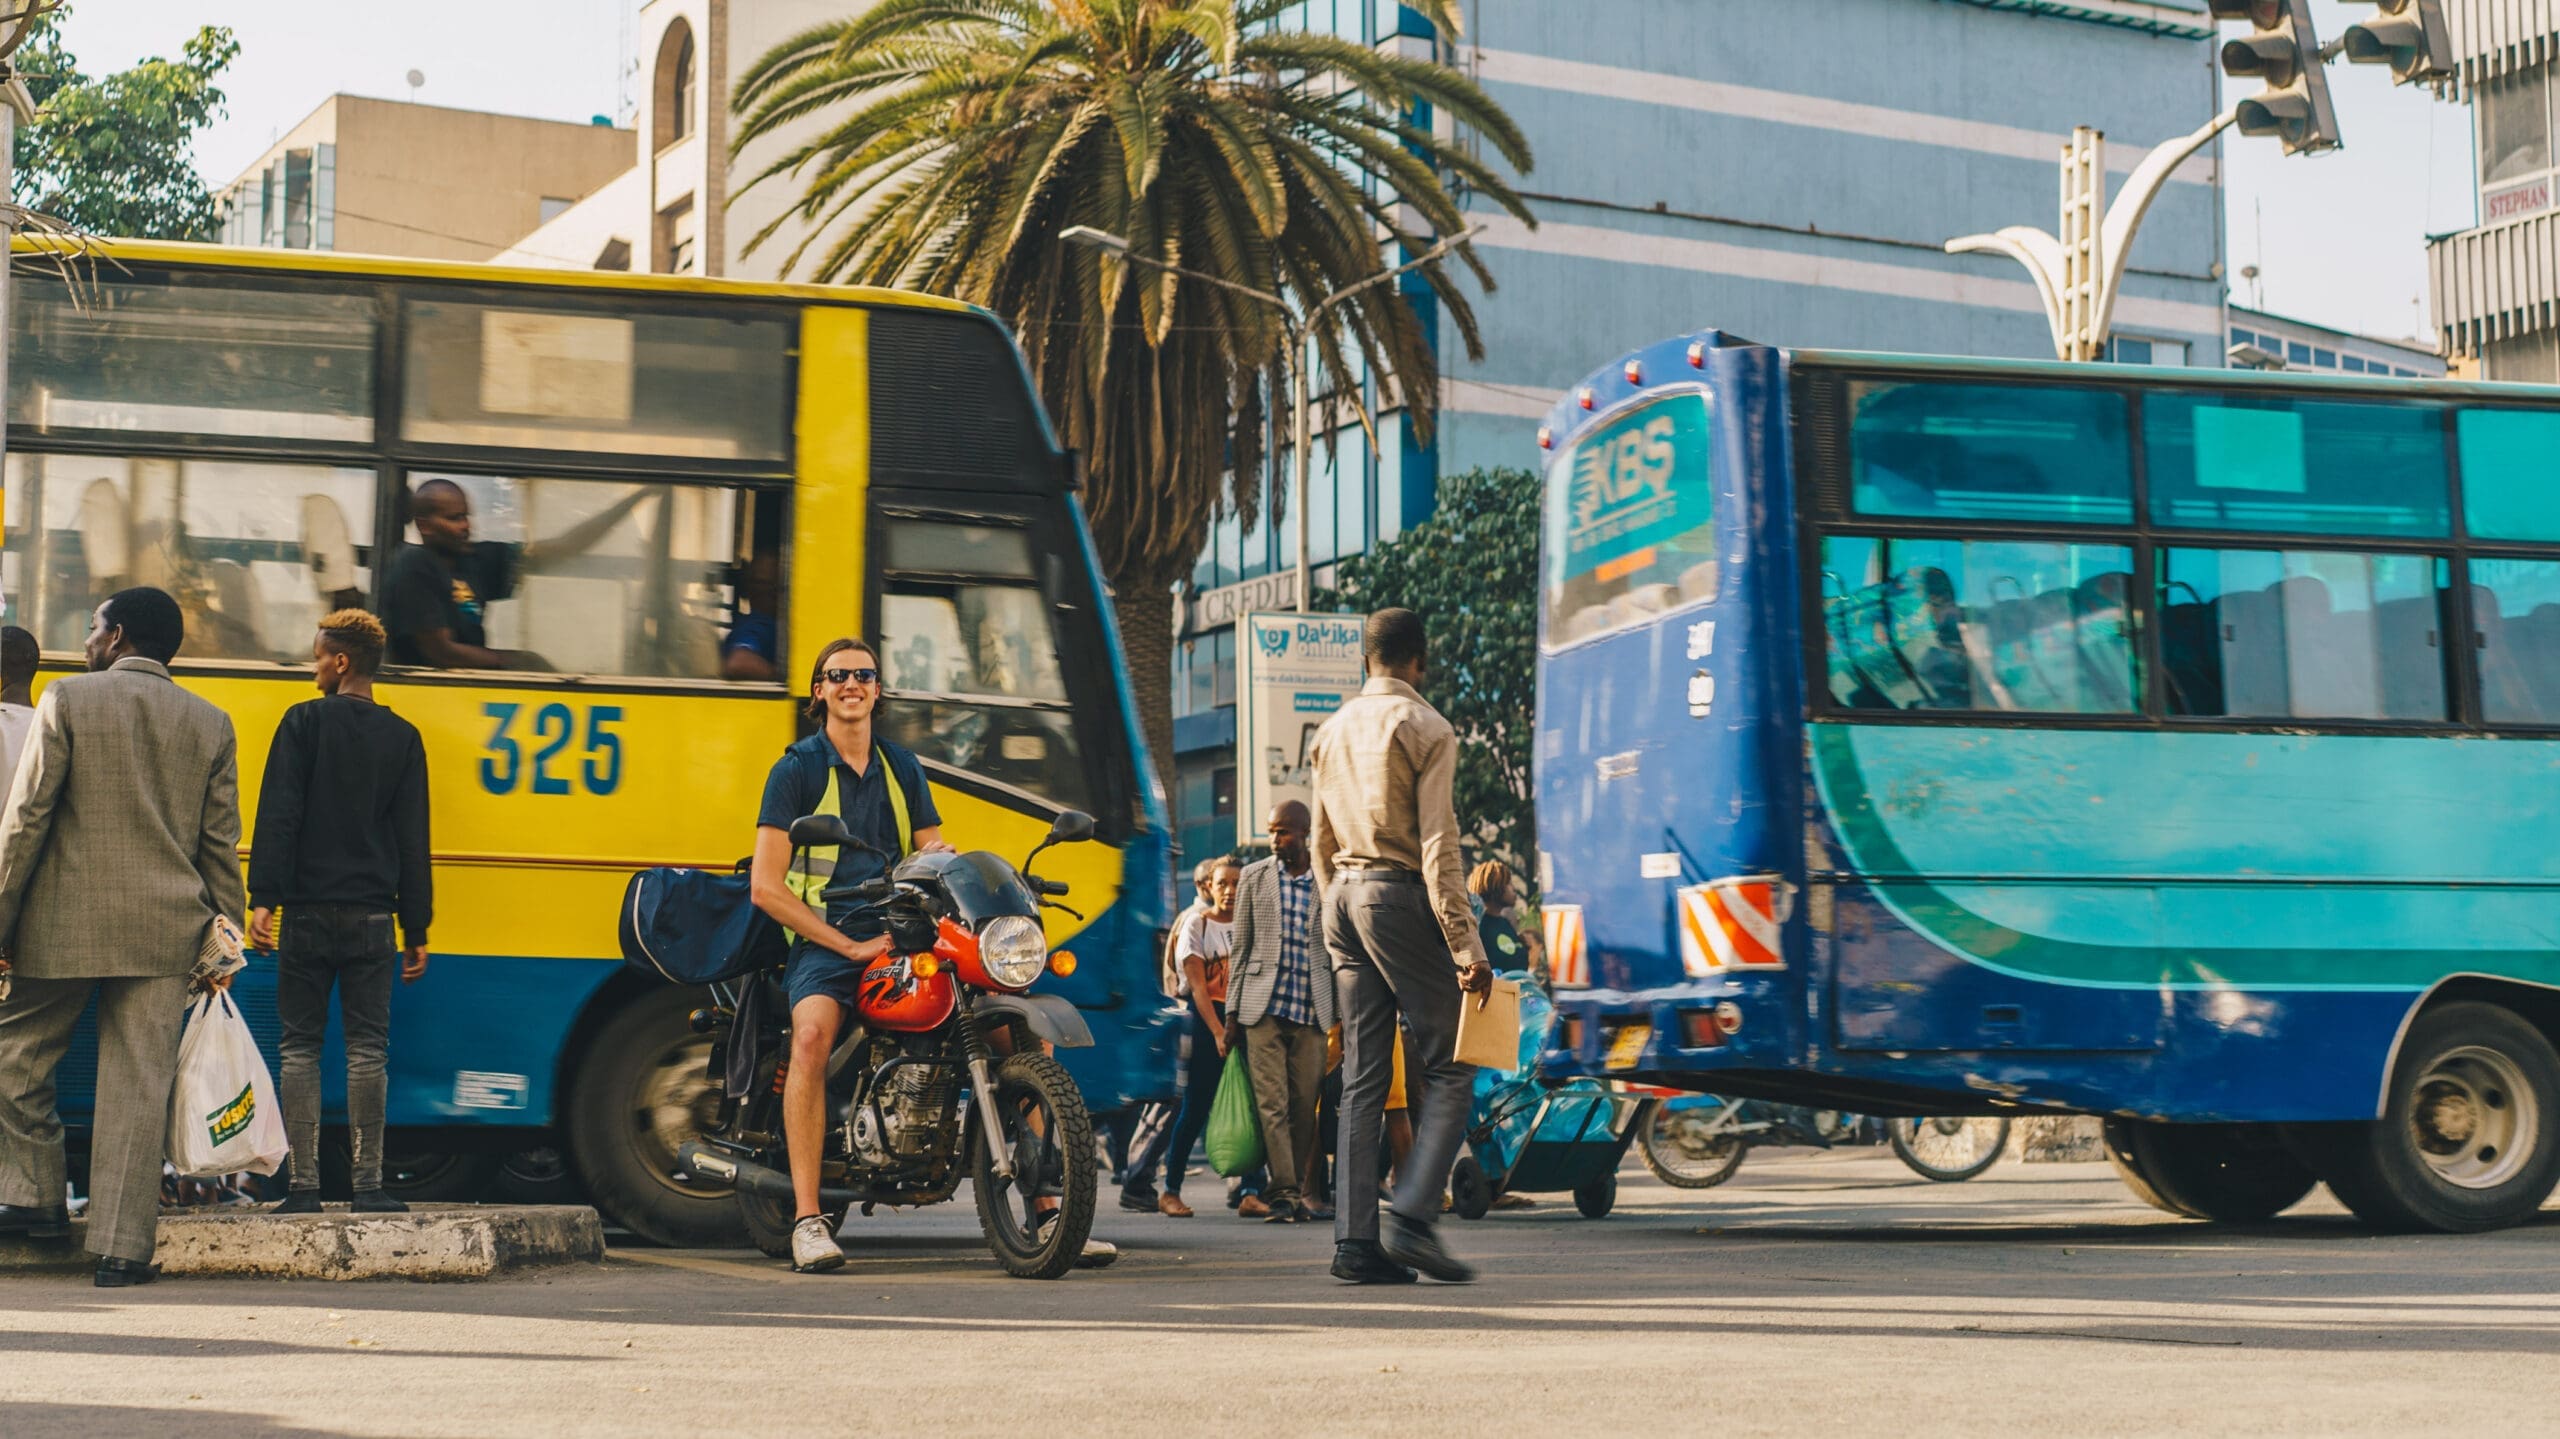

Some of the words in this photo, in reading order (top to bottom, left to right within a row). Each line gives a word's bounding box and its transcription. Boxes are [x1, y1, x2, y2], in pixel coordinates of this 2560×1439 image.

[2490, 186, 2548, 218] STEPHAN
[1574, 415, 1676, 522] KBS
[1206, 574, 1297, 623] CREDIT
[481, 702, 623, 795] 325
